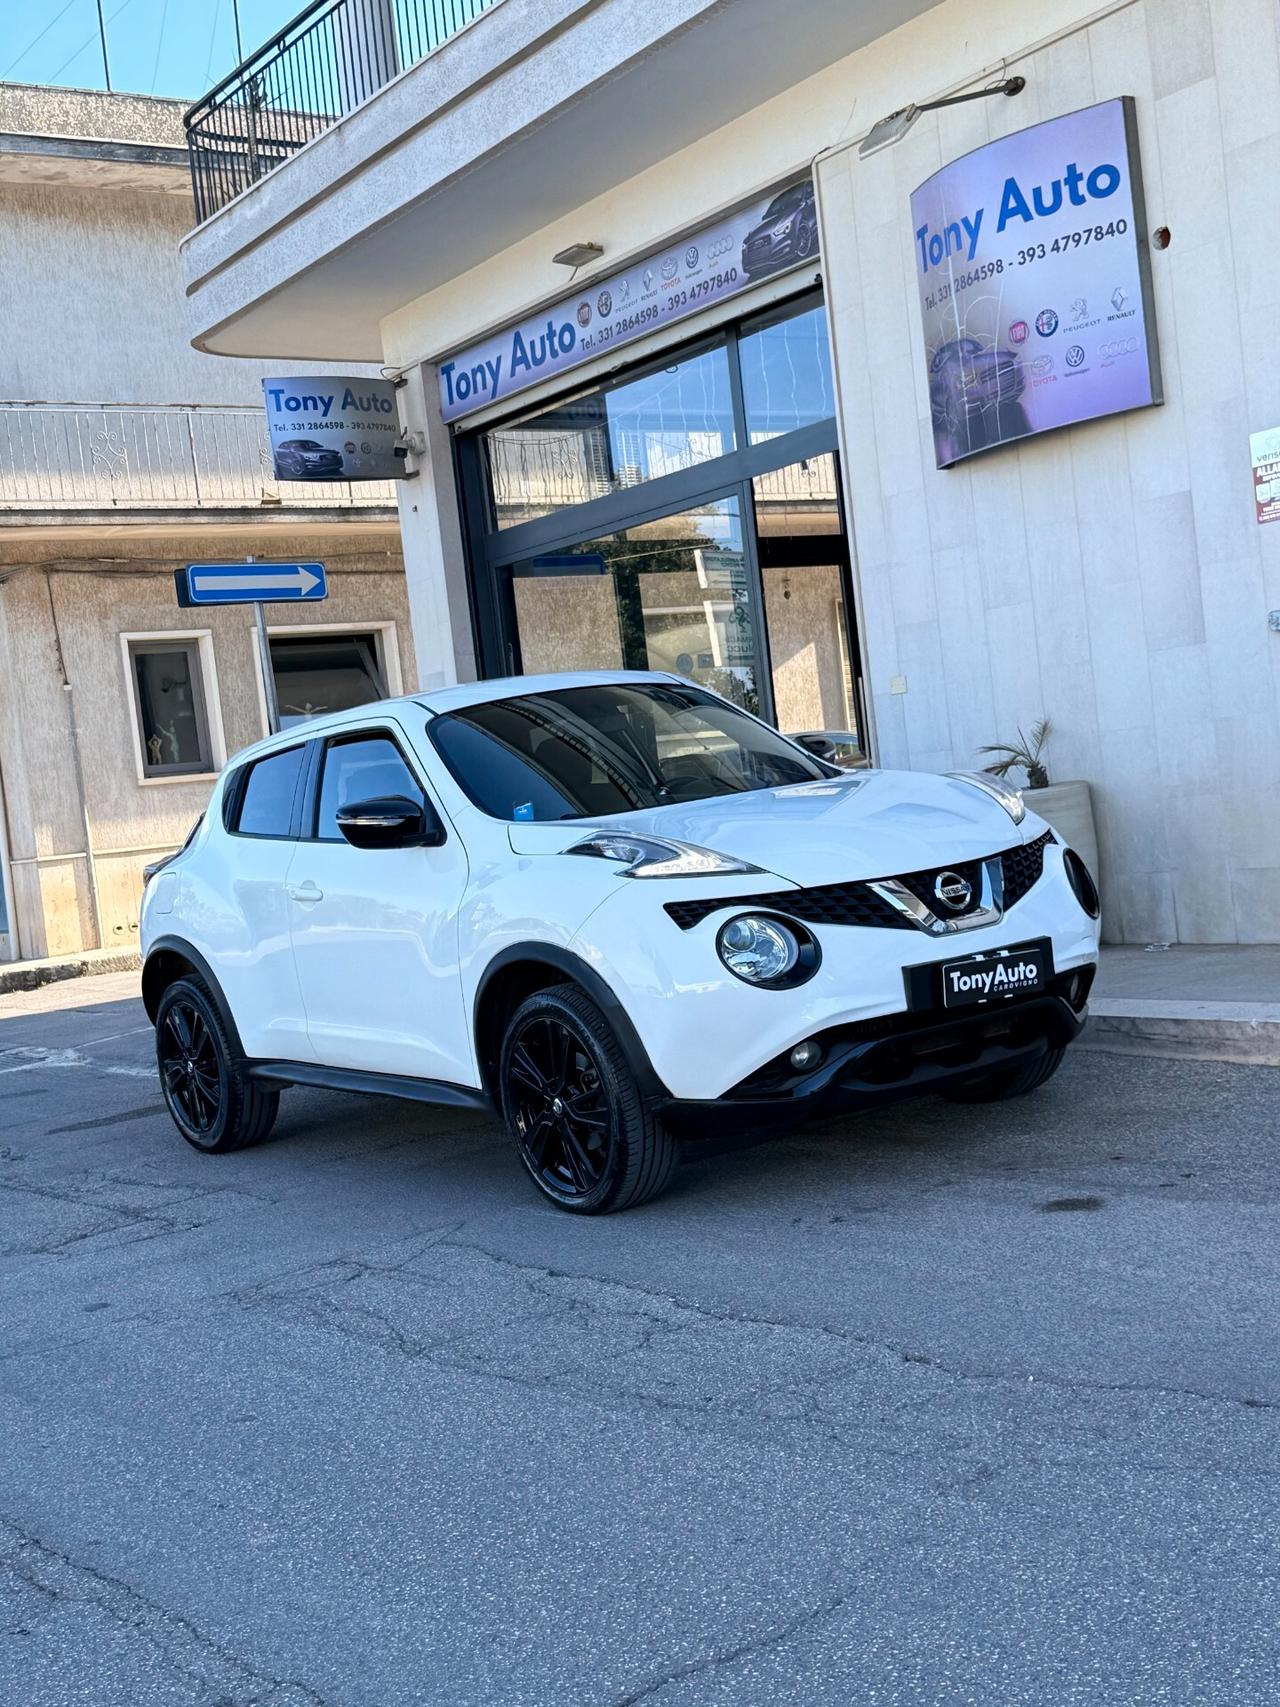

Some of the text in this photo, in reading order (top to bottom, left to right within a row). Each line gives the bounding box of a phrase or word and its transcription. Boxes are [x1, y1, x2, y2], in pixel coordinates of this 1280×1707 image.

[917, 163, 1121, 273] Tony Auto
[925, 294, 937, 311] Tel.
[953, 259, 1004, 294] 2864598
[1018, 244, 1046, 266] 393
[1050, 218, 1127, 255] 4797840
[660, 278, 682, 292] TOYOTA
[580, 333, 596, 350] Tel.
[598, 326, 613, 344] 331
[616, 305, 659, 335] 2864598
[667, 295, 687, 312] 393
[689, 267, 737, 300] 4797840
[1063, 319, 1101, 333] PEUGEOT
[1107, 309, 1136, 322] RENAULT
[441, 320, 576, 406] Tony Auto
[268, 387, 393, 417] Tony Auto
[273, 424, 288, 432] Tel.
[291, 423, 305, 431] 331
[308, 421, 344, 431] 2864598
[351, 422, 365, 430] 393
[366, 423, 396, 432] 4797840
[941, 885, 969, 896] NISSA
[950, 962, 1037, 993] TonyAuto
[994, 978, 1038, 992] CAROVIGNO
